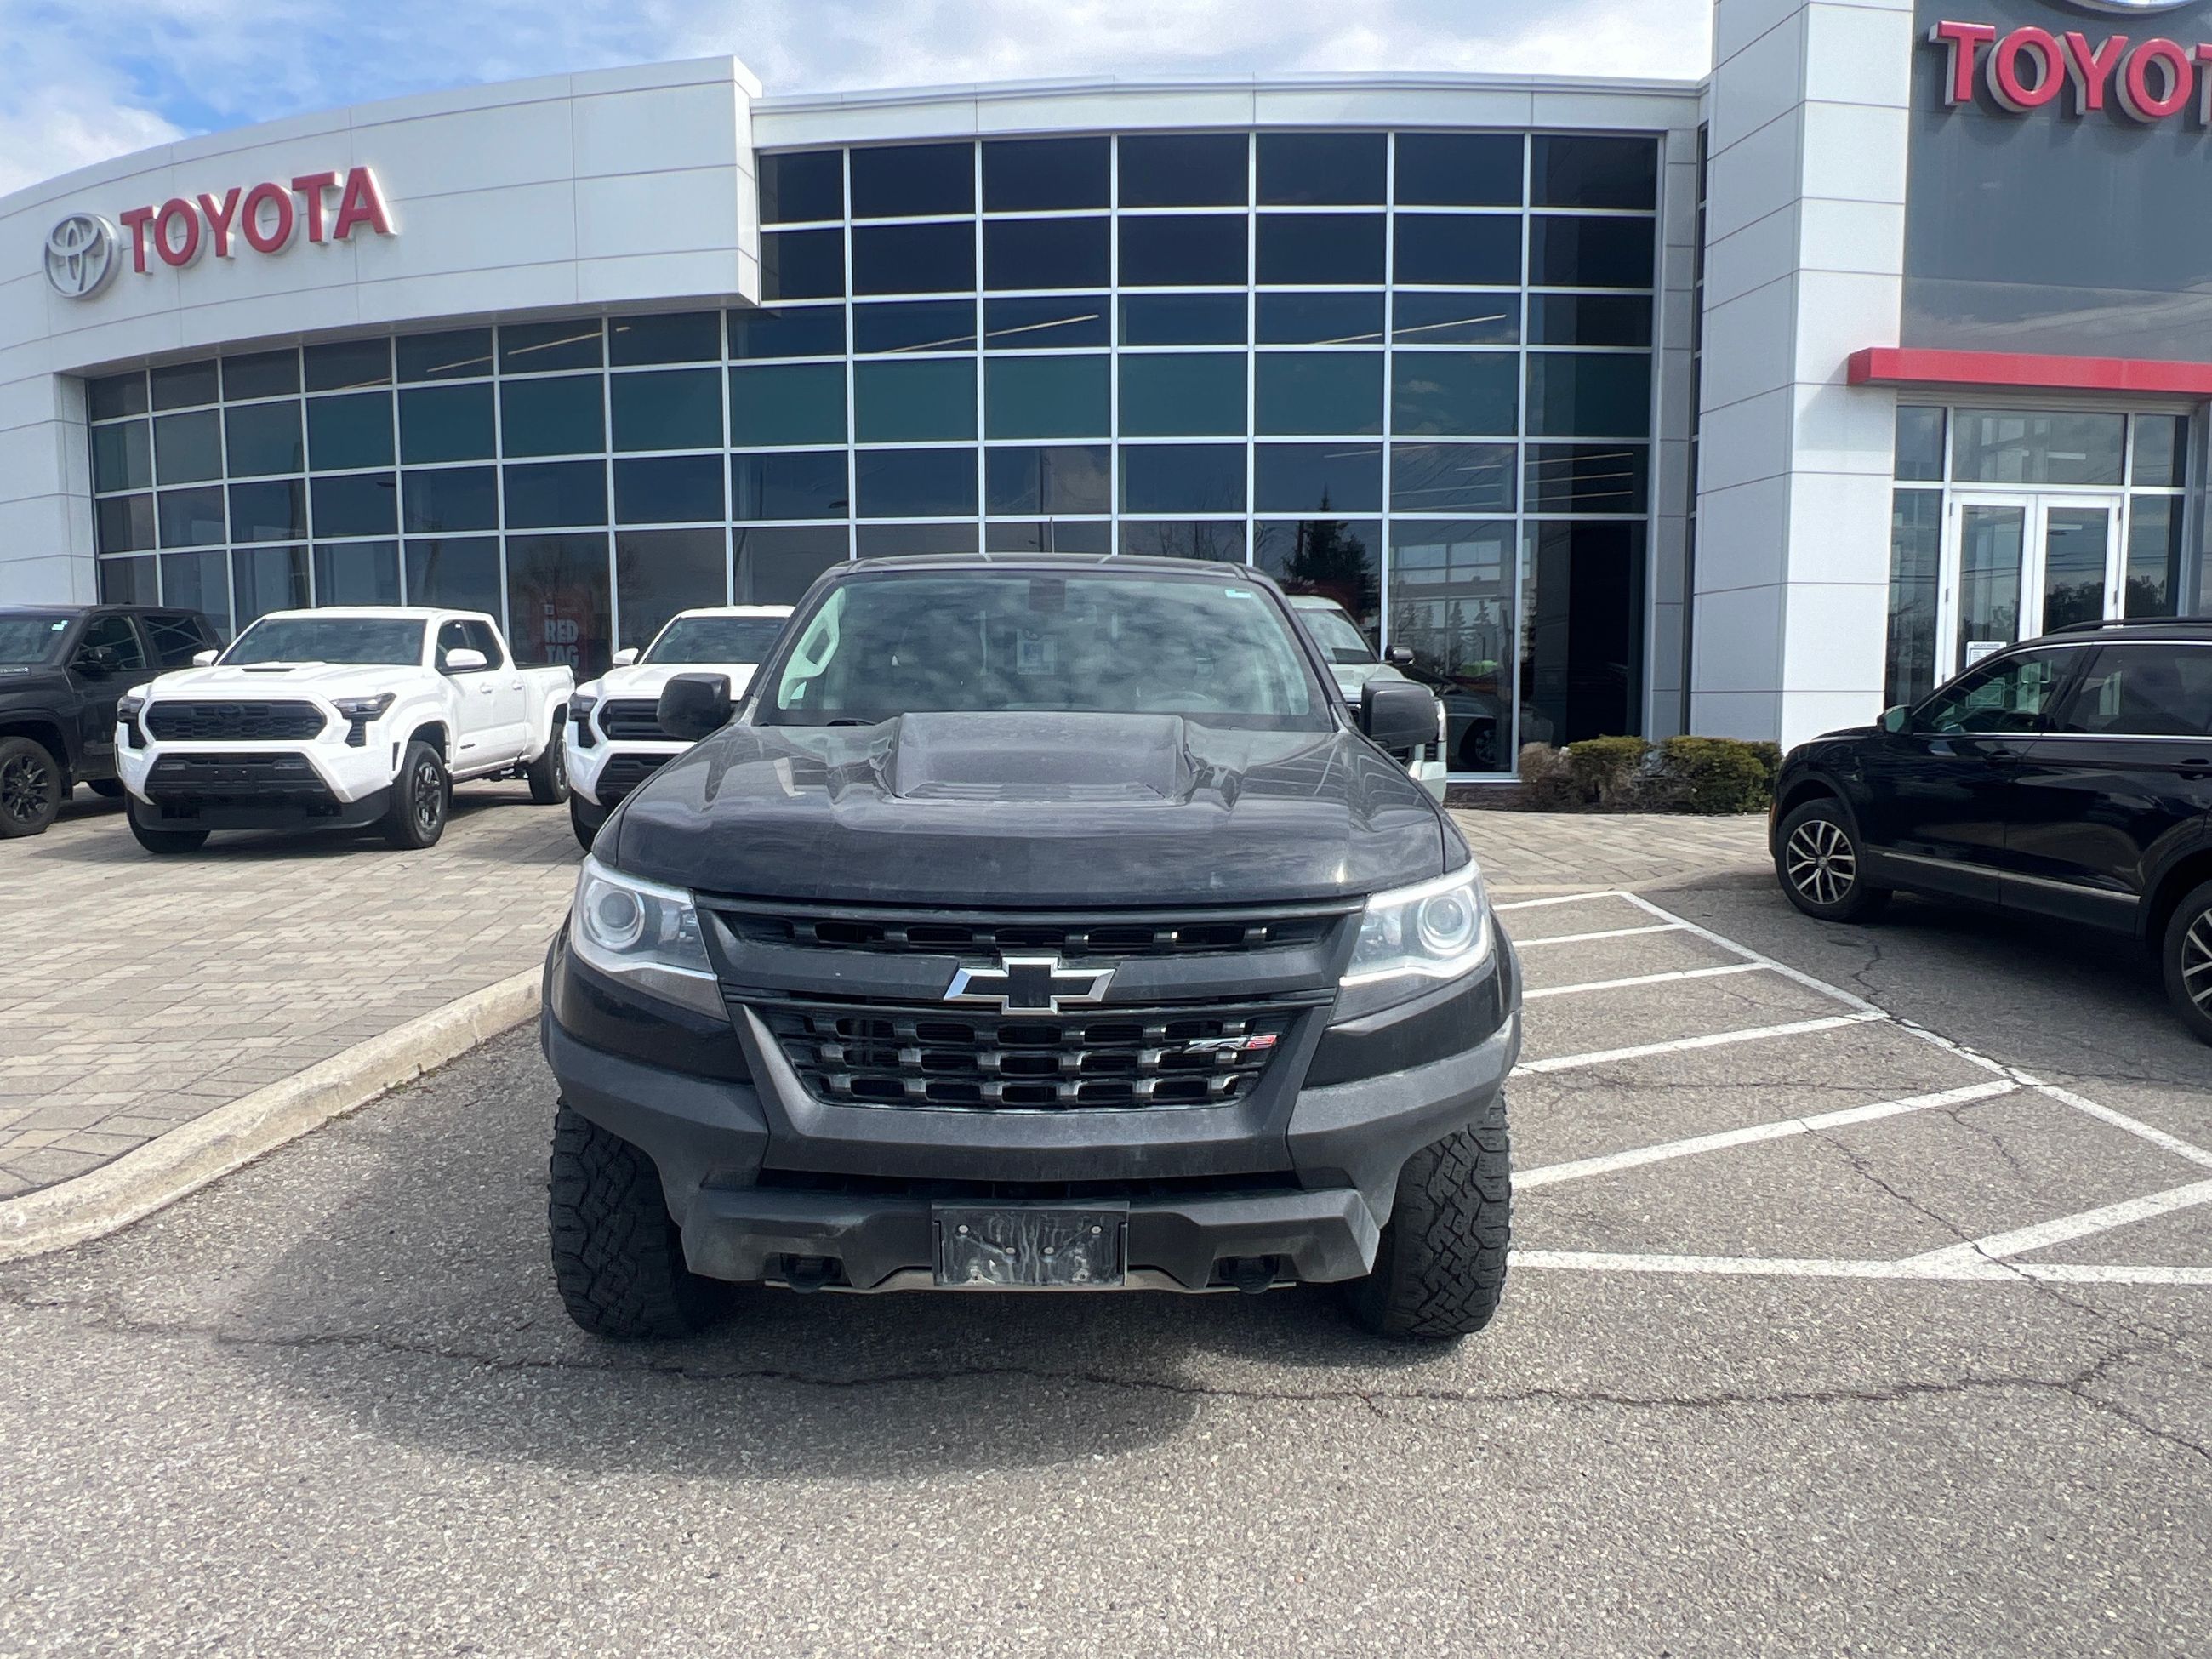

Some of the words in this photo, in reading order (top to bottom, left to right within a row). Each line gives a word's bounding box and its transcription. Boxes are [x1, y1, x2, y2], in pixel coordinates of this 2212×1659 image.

[120, 166, 396, 274] TOYOTA
[544, 619, 579, 643] RED
[544, 645, 579, 670] TAG
[1183, 1035, 1278, 1054] ZR2
